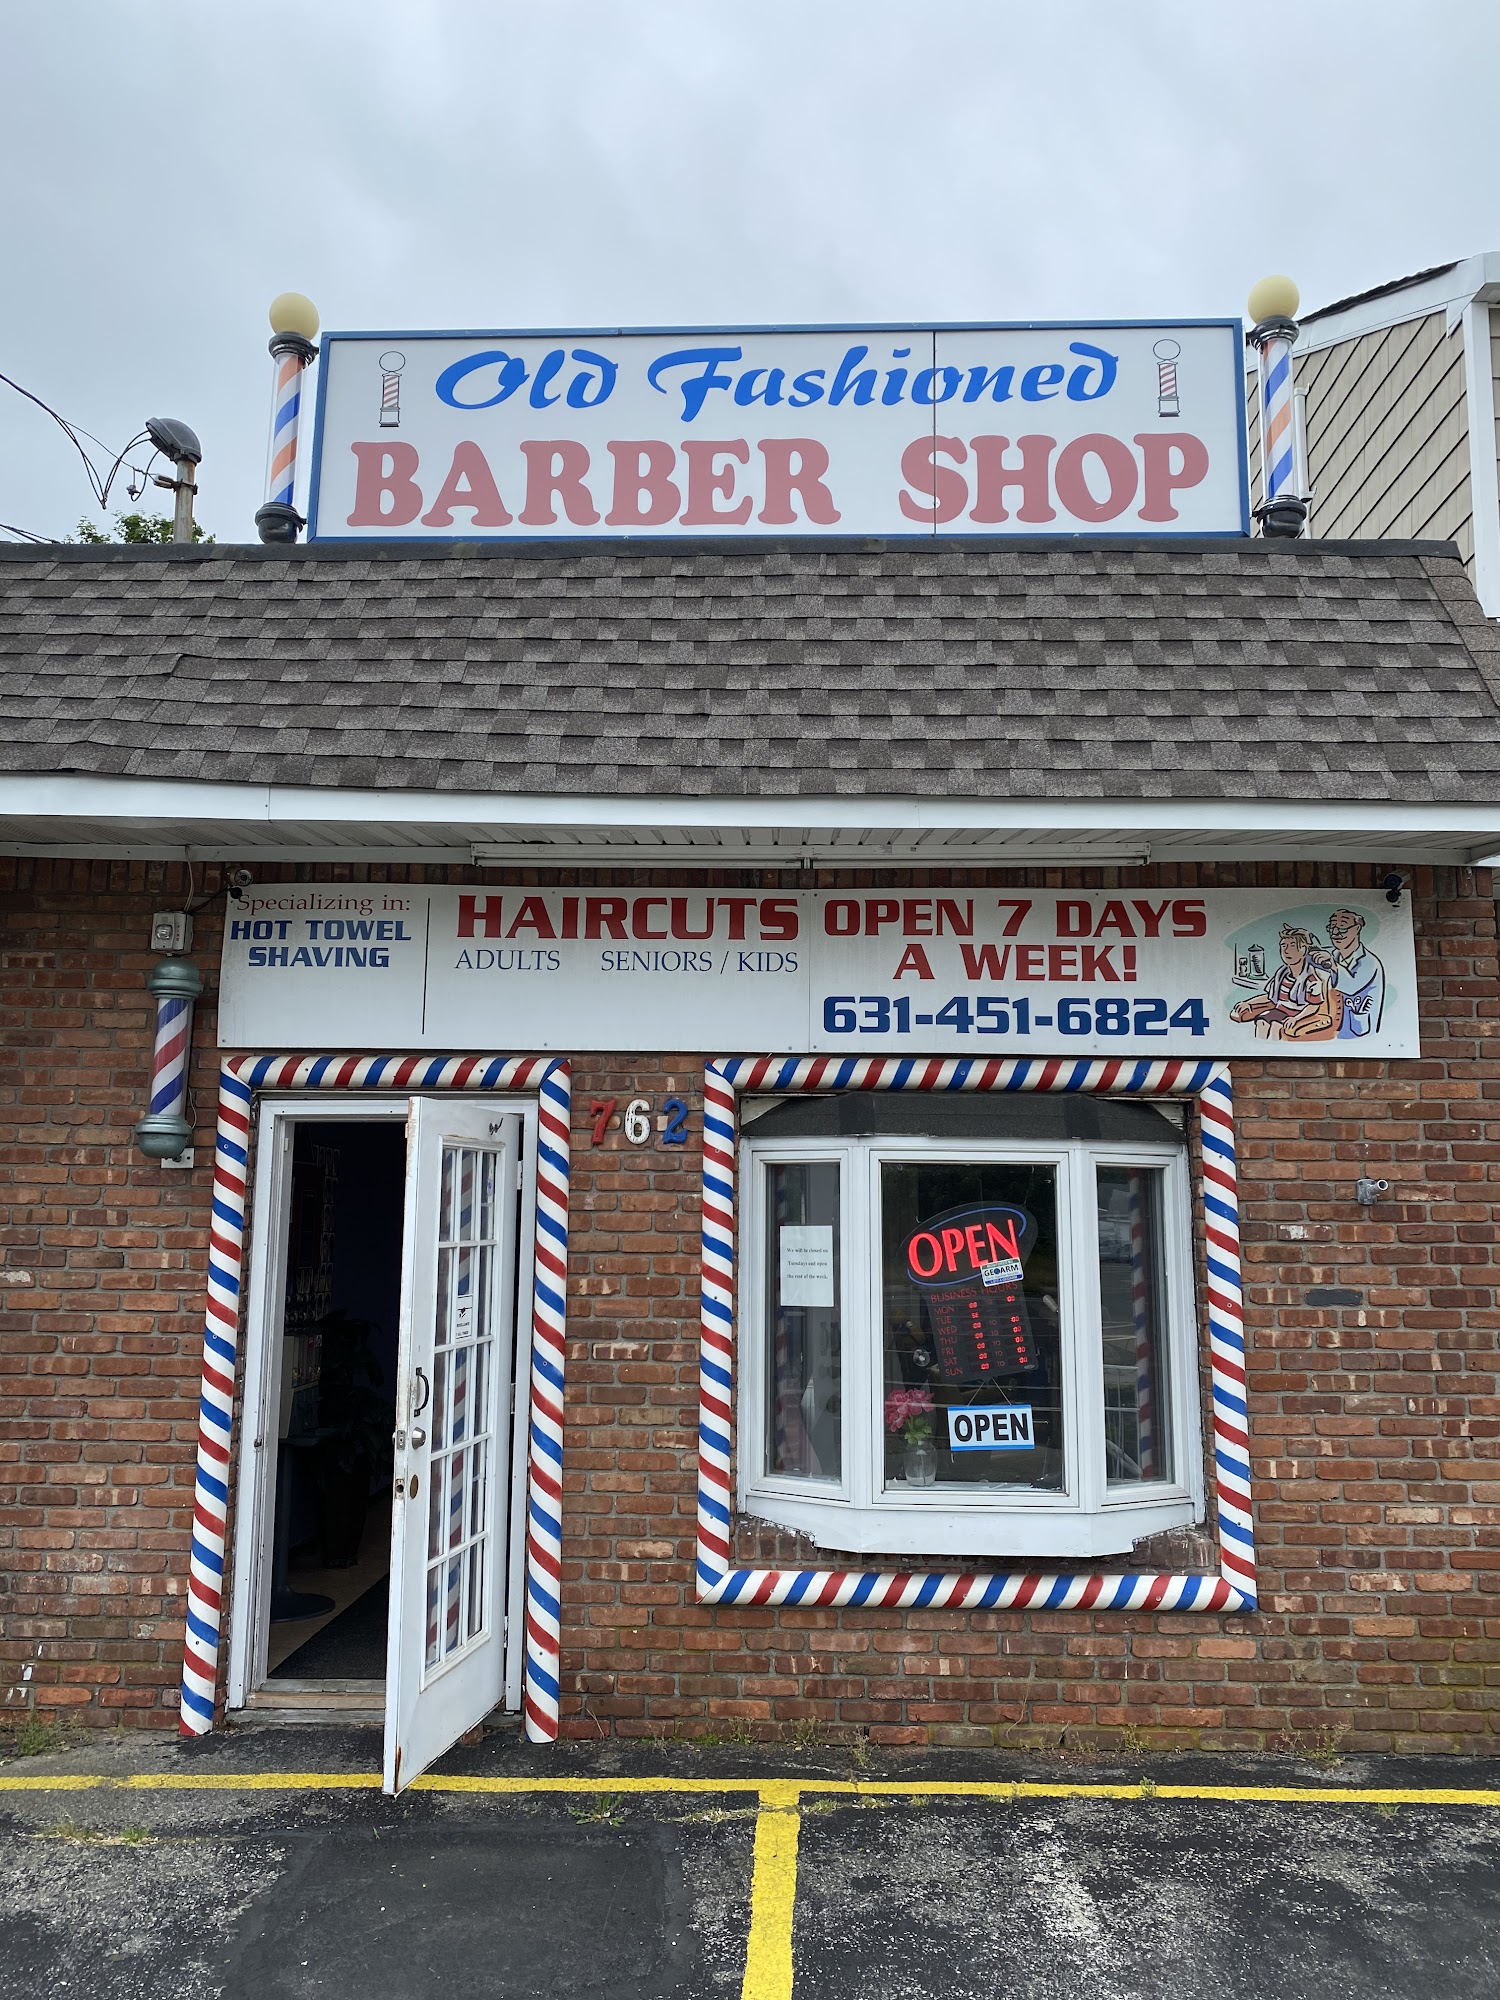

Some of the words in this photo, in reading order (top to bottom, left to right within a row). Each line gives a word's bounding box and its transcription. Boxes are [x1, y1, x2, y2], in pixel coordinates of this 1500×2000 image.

[435, 349, 619, 410] Old
[647, 342, 1119, 423] Fashioned
[347, 438, 840, 527] BARBER
[899, 433, 1209, 524] SHOP
[237, 894, 374, 916] Specializing
[382, 895, 411, 911] in:
[456, 894, 799, 941] HAIRCUTS
[824, 898, 974, 938] OPEN
[998, 899, 1033, 938] 7
[1056, 899, 1208, 939] DAYS
[230, 920, 293, 941] HOT
[305, 920, 412, 941] TOWEL
[248, 946, 390, 968] SHAVING
[454, 949, 561, 971] ADULTS
[601, 950, 713, 972] SENIORS
[736, 951, 798, 973] KIDS
[893, 943, 935, 981] A
[960, 943, 1137, 982] WEEK!
[823, 995, 1210, 1037] 631-451-6824
[590, 1097, 689, 1145] 762
[908, 1218, 1020, 1277] OPEN
[984, 1264, 1019, 1276] GEOARM
[930, 1288, 977, 1303] BUSINESS
[981, 1282, 1018, 1295] HOURS
[934, 1306, 955, 1315] MON
[936, 1317, 951, 1325] TUE
[937, 1326, 957, 1335] WED
[940, 1337, 957, 1345] THU
[942, 1348, 954, 1356] FRI
[944, 1357, 958, 1366] SAT
[945, 1368, 963, 1377] SUN
[954, 1413, 1029, 1442] OPEN
